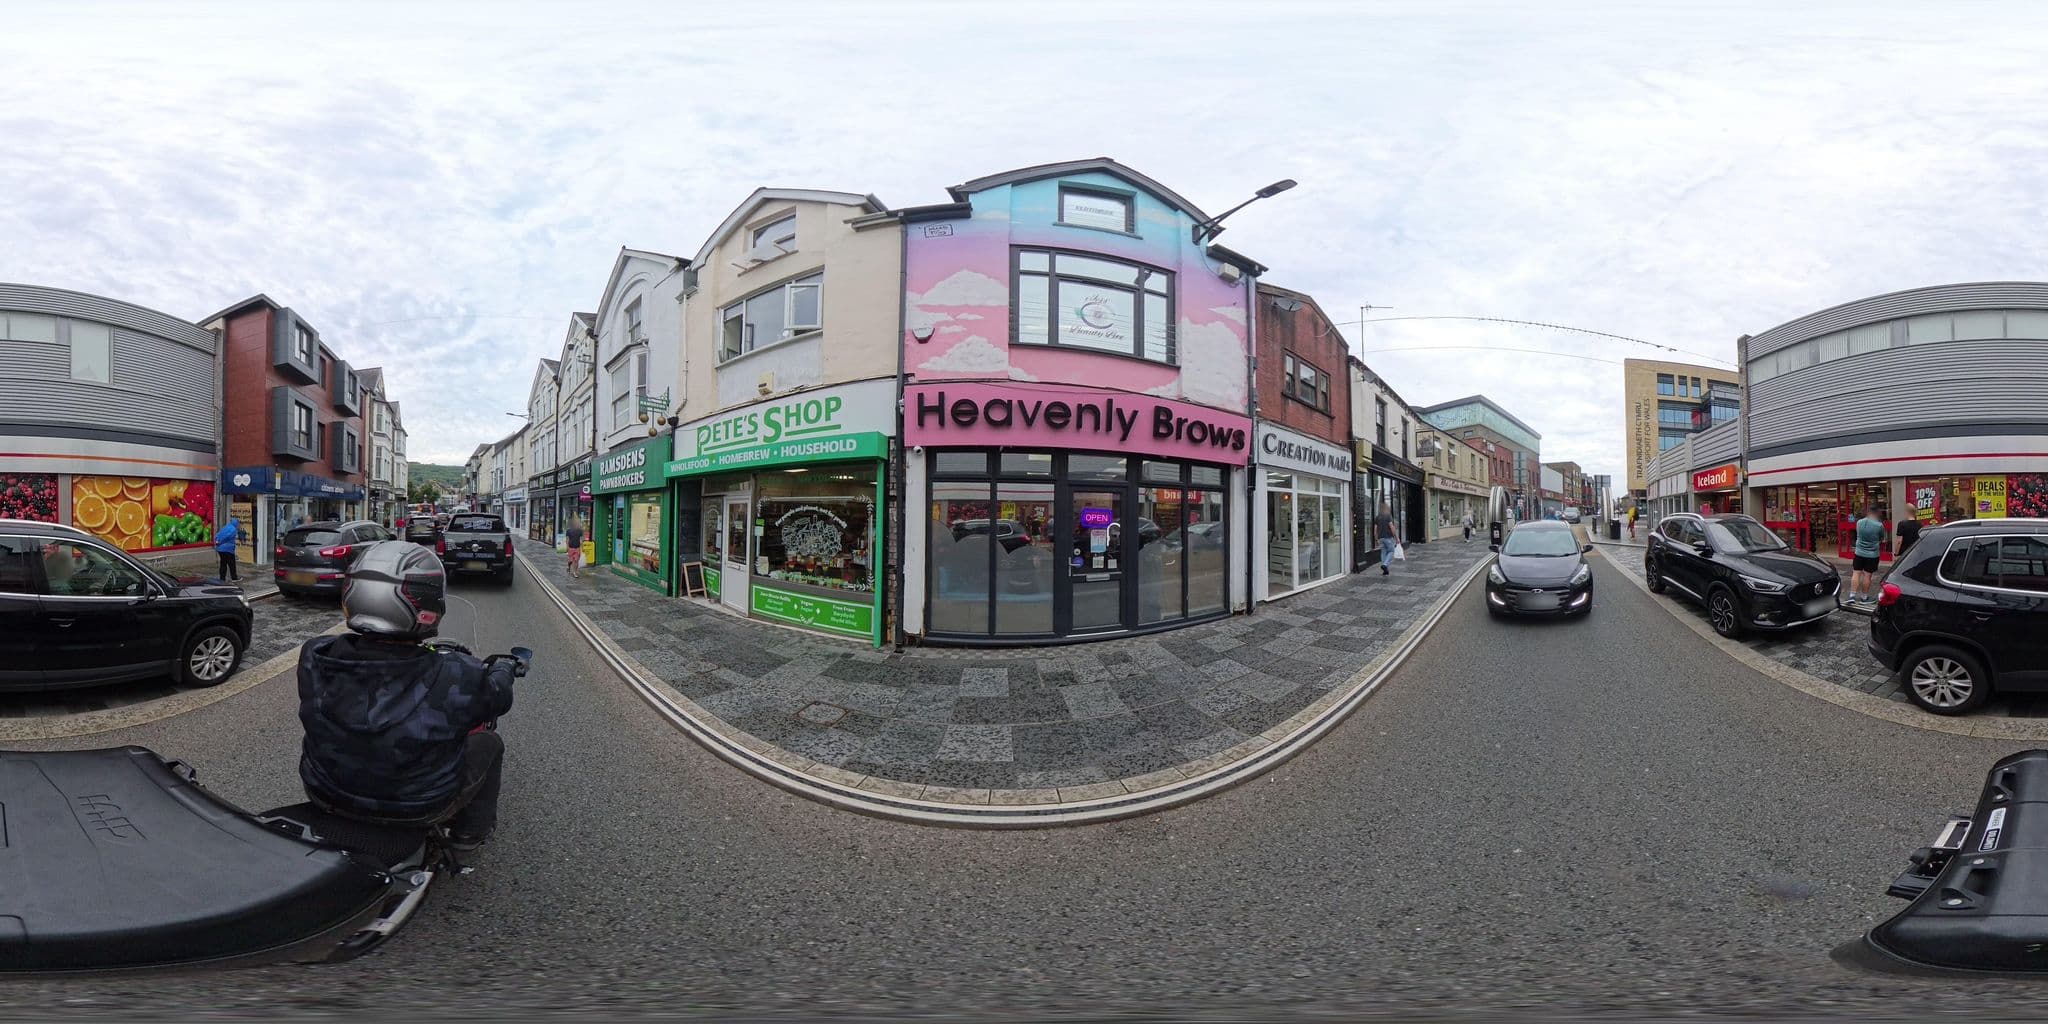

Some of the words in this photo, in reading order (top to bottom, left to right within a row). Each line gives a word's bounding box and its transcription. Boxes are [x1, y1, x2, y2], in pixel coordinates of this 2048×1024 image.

[697, 412, 758, 456] PETE'S
[763, 396, 842, 443] SHOP
[917, 392, 1138, 442] Heavenly
[1152, 405, 1246, 451] Brows
[600, 448, 645, 476] RAMSDENS
[670, 458, 710, 472] WHOLEFOOD
[719, 449, 770, 464] HOMEBREW
[780, 439, 857, 457] HOUSEHOLD
[600, 470, 644, 490] PAWNBROKERS
[1697, 470, 1726, 488] Iceland
[1978, 481, 2004, 492] DEALS
[1916, 487, 1936, 499] 10%
[1918, 498, 1932, 509] OFF
[1086, 514, 1108, 522] OPEN
